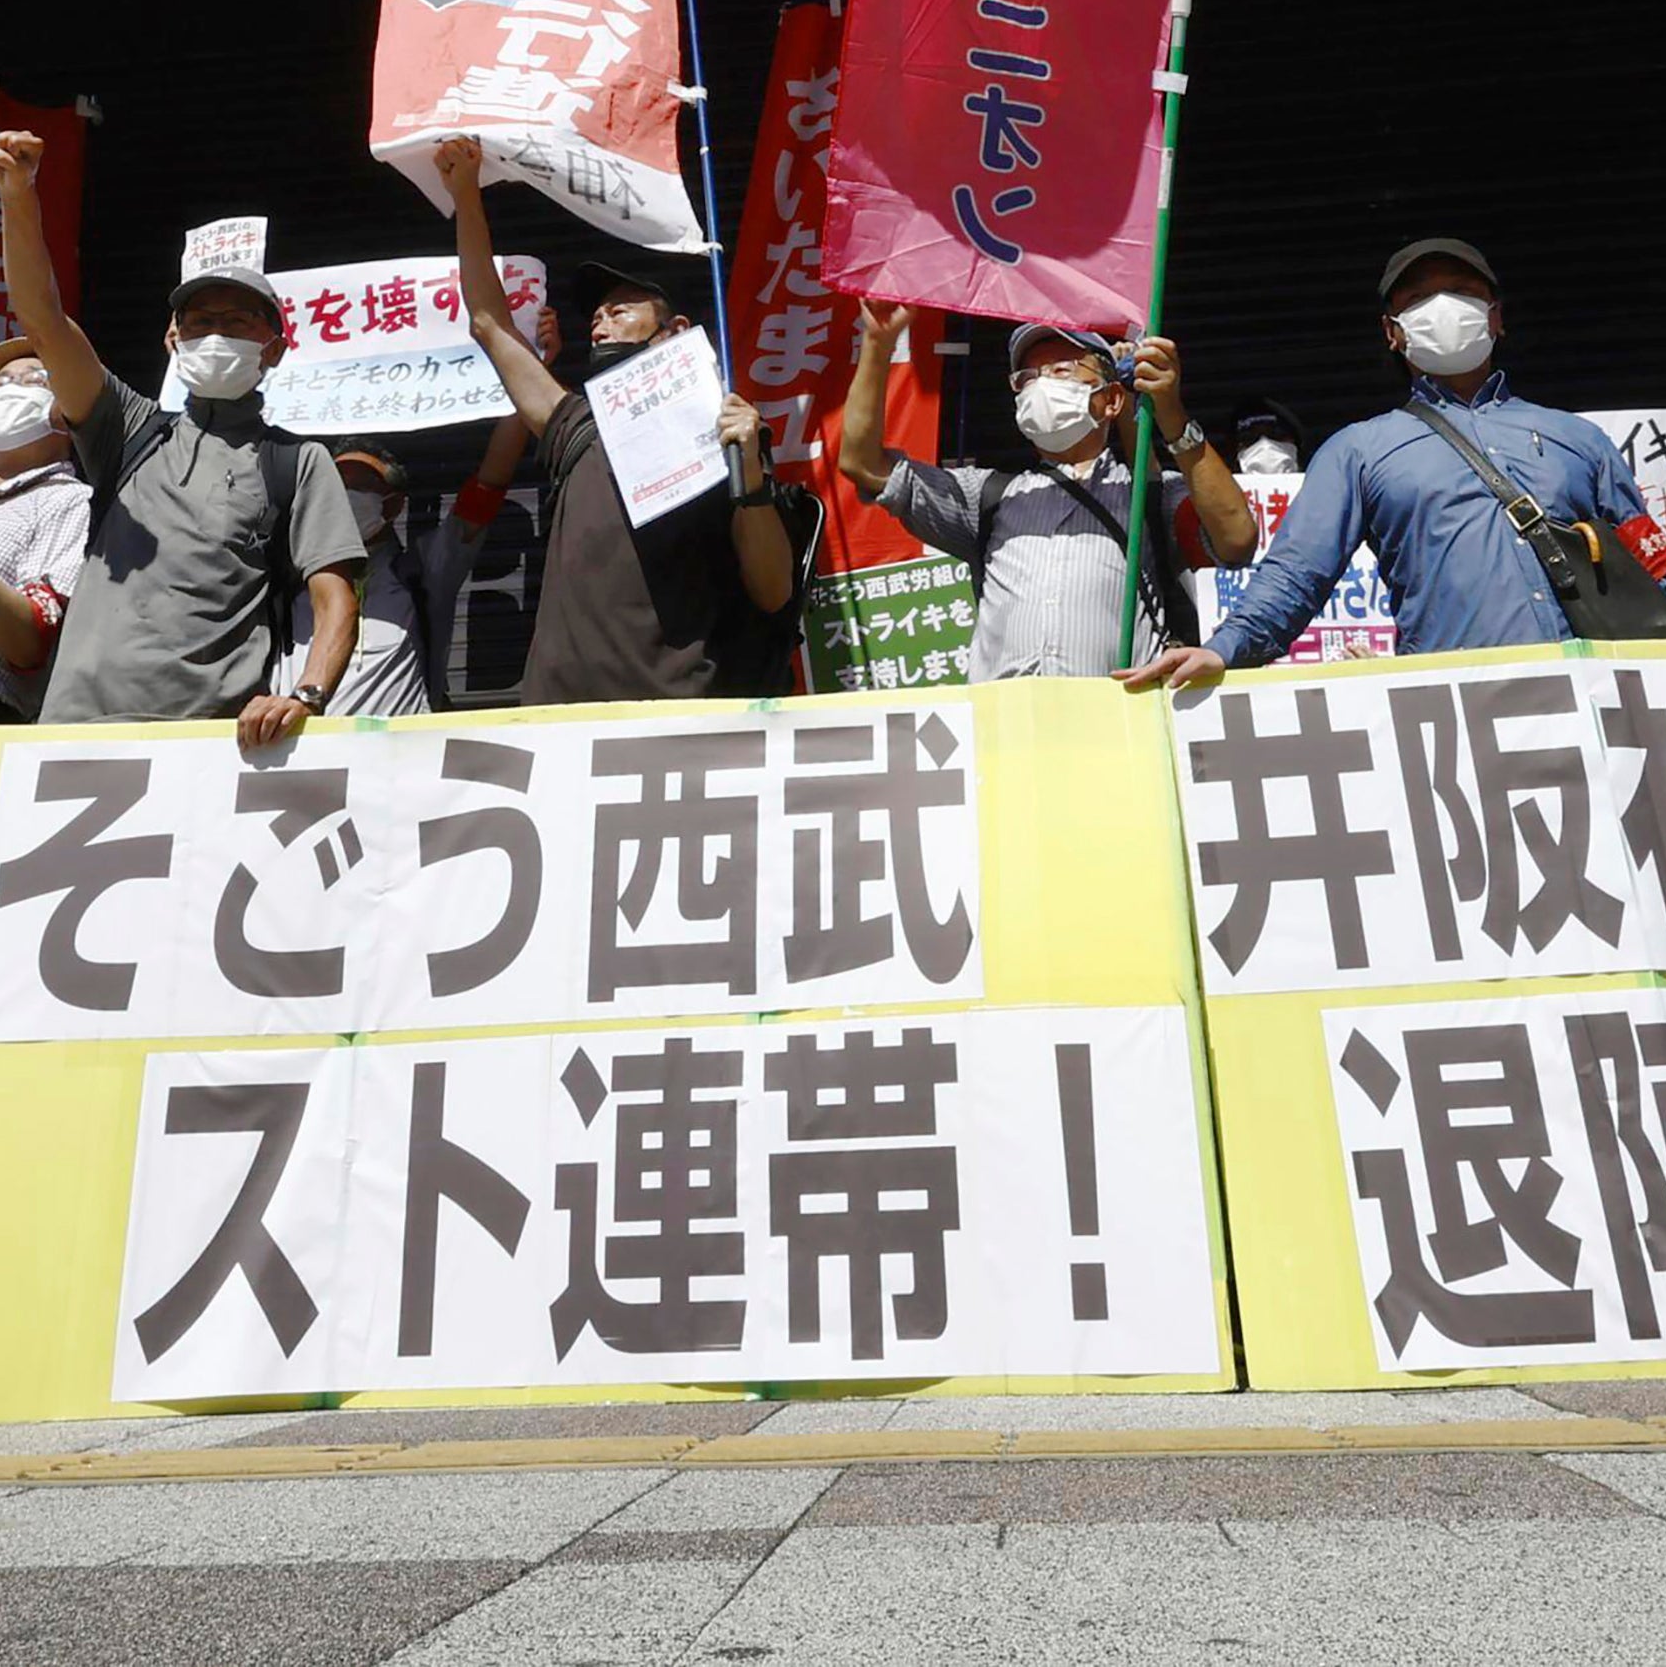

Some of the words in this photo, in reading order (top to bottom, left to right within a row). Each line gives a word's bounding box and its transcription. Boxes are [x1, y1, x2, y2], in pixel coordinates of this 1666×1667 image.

[189, 231, 257, 261] ストライキ
[606, 350, 697, 417] ストライキ
[823, 598, 975, 650] ストライキを
[133, 1027, 1108, 1363] スト連帯！
